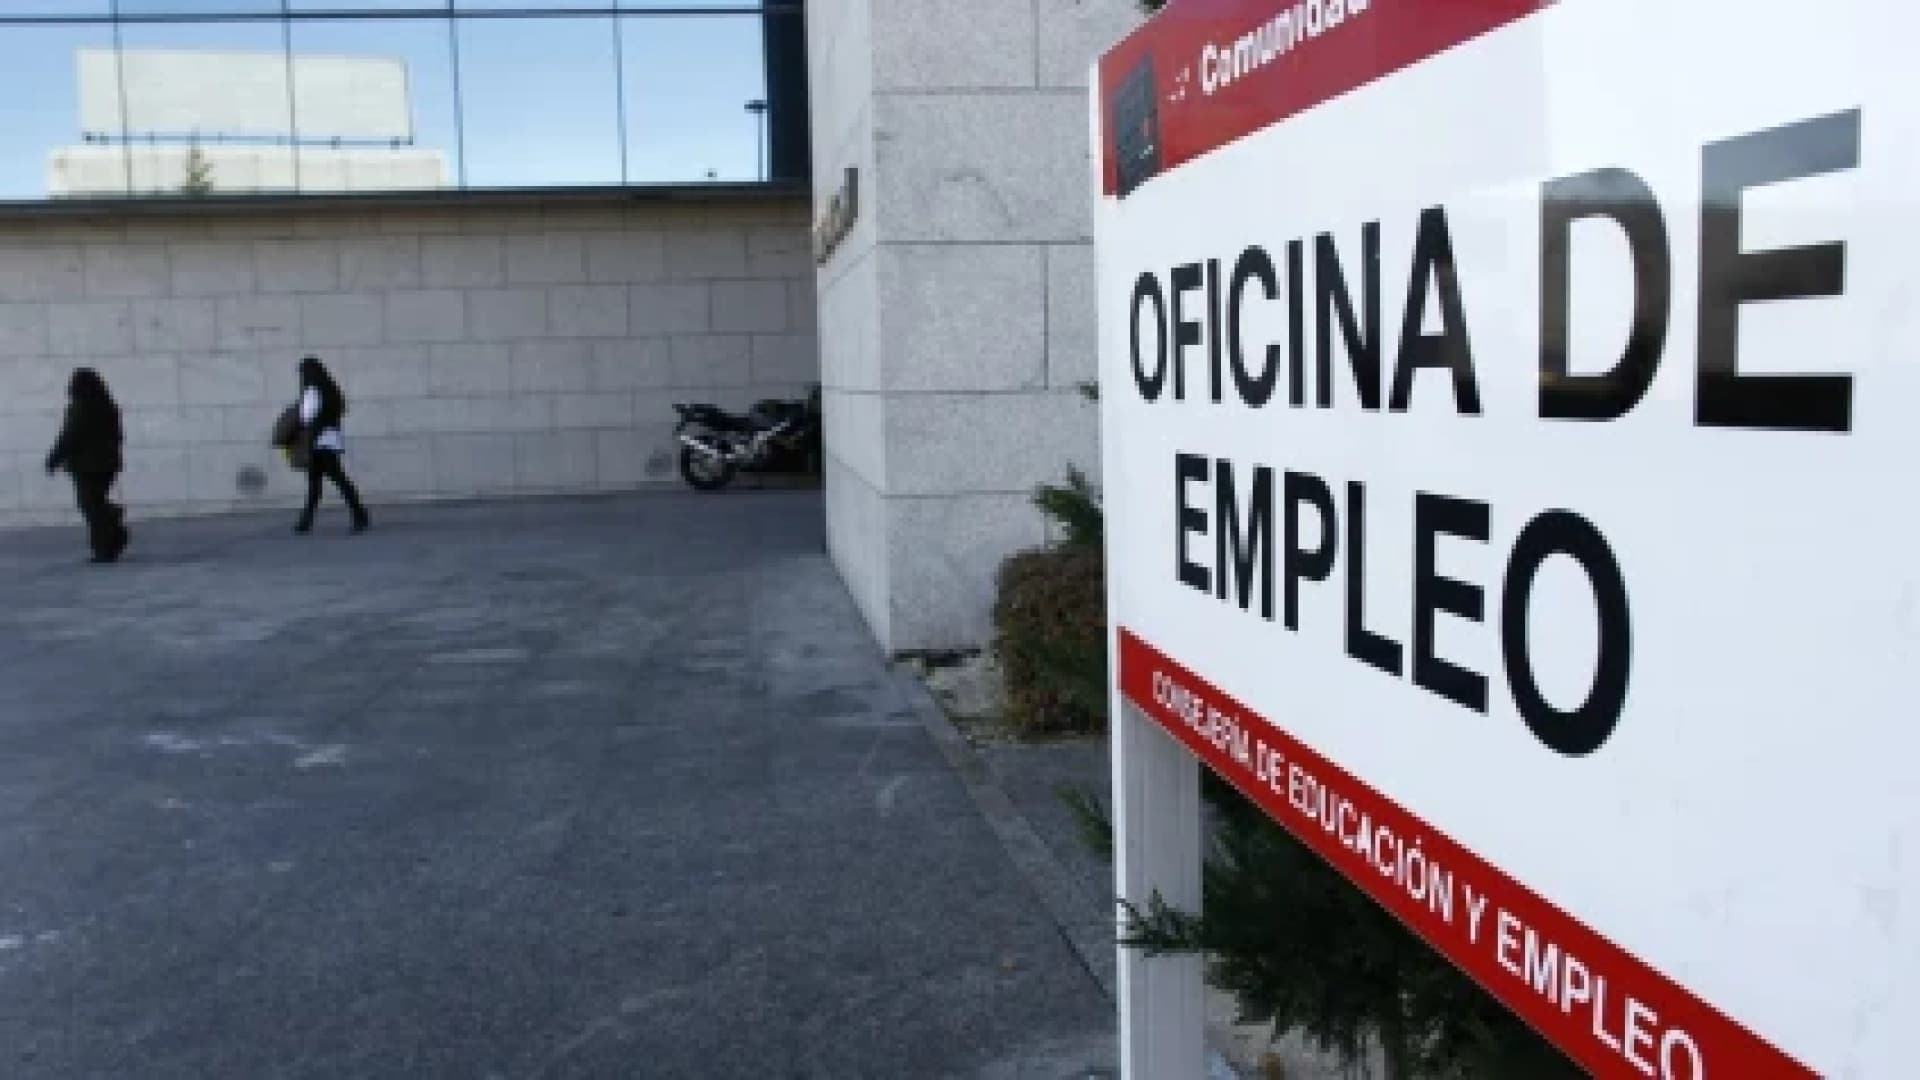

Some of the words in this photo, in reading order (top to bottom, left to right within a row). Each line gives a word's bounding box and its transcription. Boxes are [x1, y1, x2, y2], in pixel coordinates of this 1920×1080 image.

[1129, 204, 1483, 416] OFICINA
[1539, 106, 1862, 434] DE
[1174, 453, 1634, 759] EMPLEO
[1152, 671, 1250, 774] CONSEJERÍA
[1256, 747, 1285, 795] DE
[1288, 766, 1455, 924] EDUCACIÓN
[1462, 886, 1491, 945] Y
[1496, 907, 1704, 1080] EMPLEO
